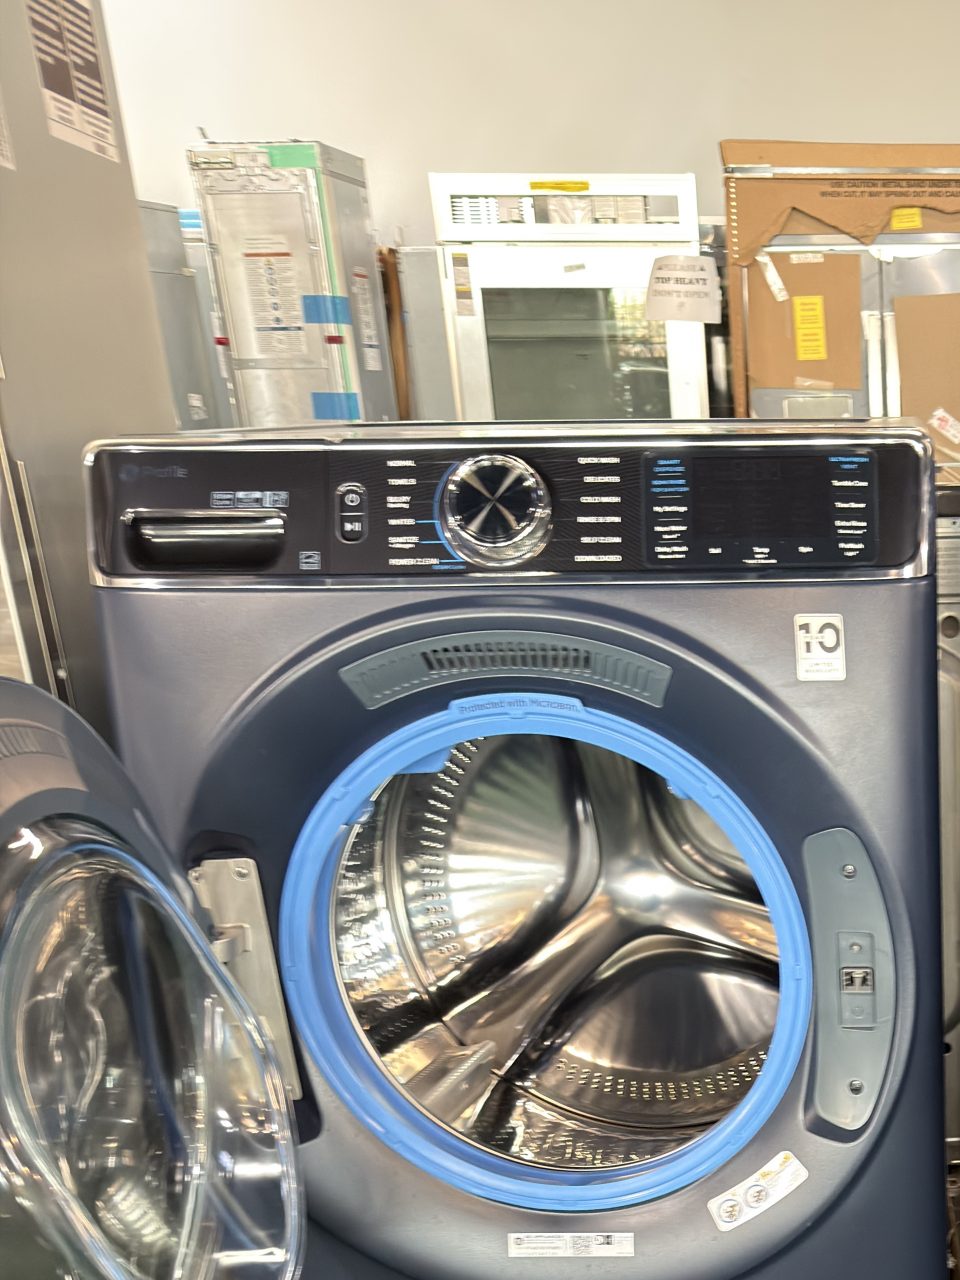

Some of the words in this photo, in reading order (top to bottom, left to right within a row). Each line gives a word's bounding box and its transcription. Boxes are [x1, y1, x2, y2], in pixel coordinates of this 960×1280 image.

[673, 276, 708, 285] HEAVY
[798, 622, 840, 654] 10
[508, 699, 527, 708] with
